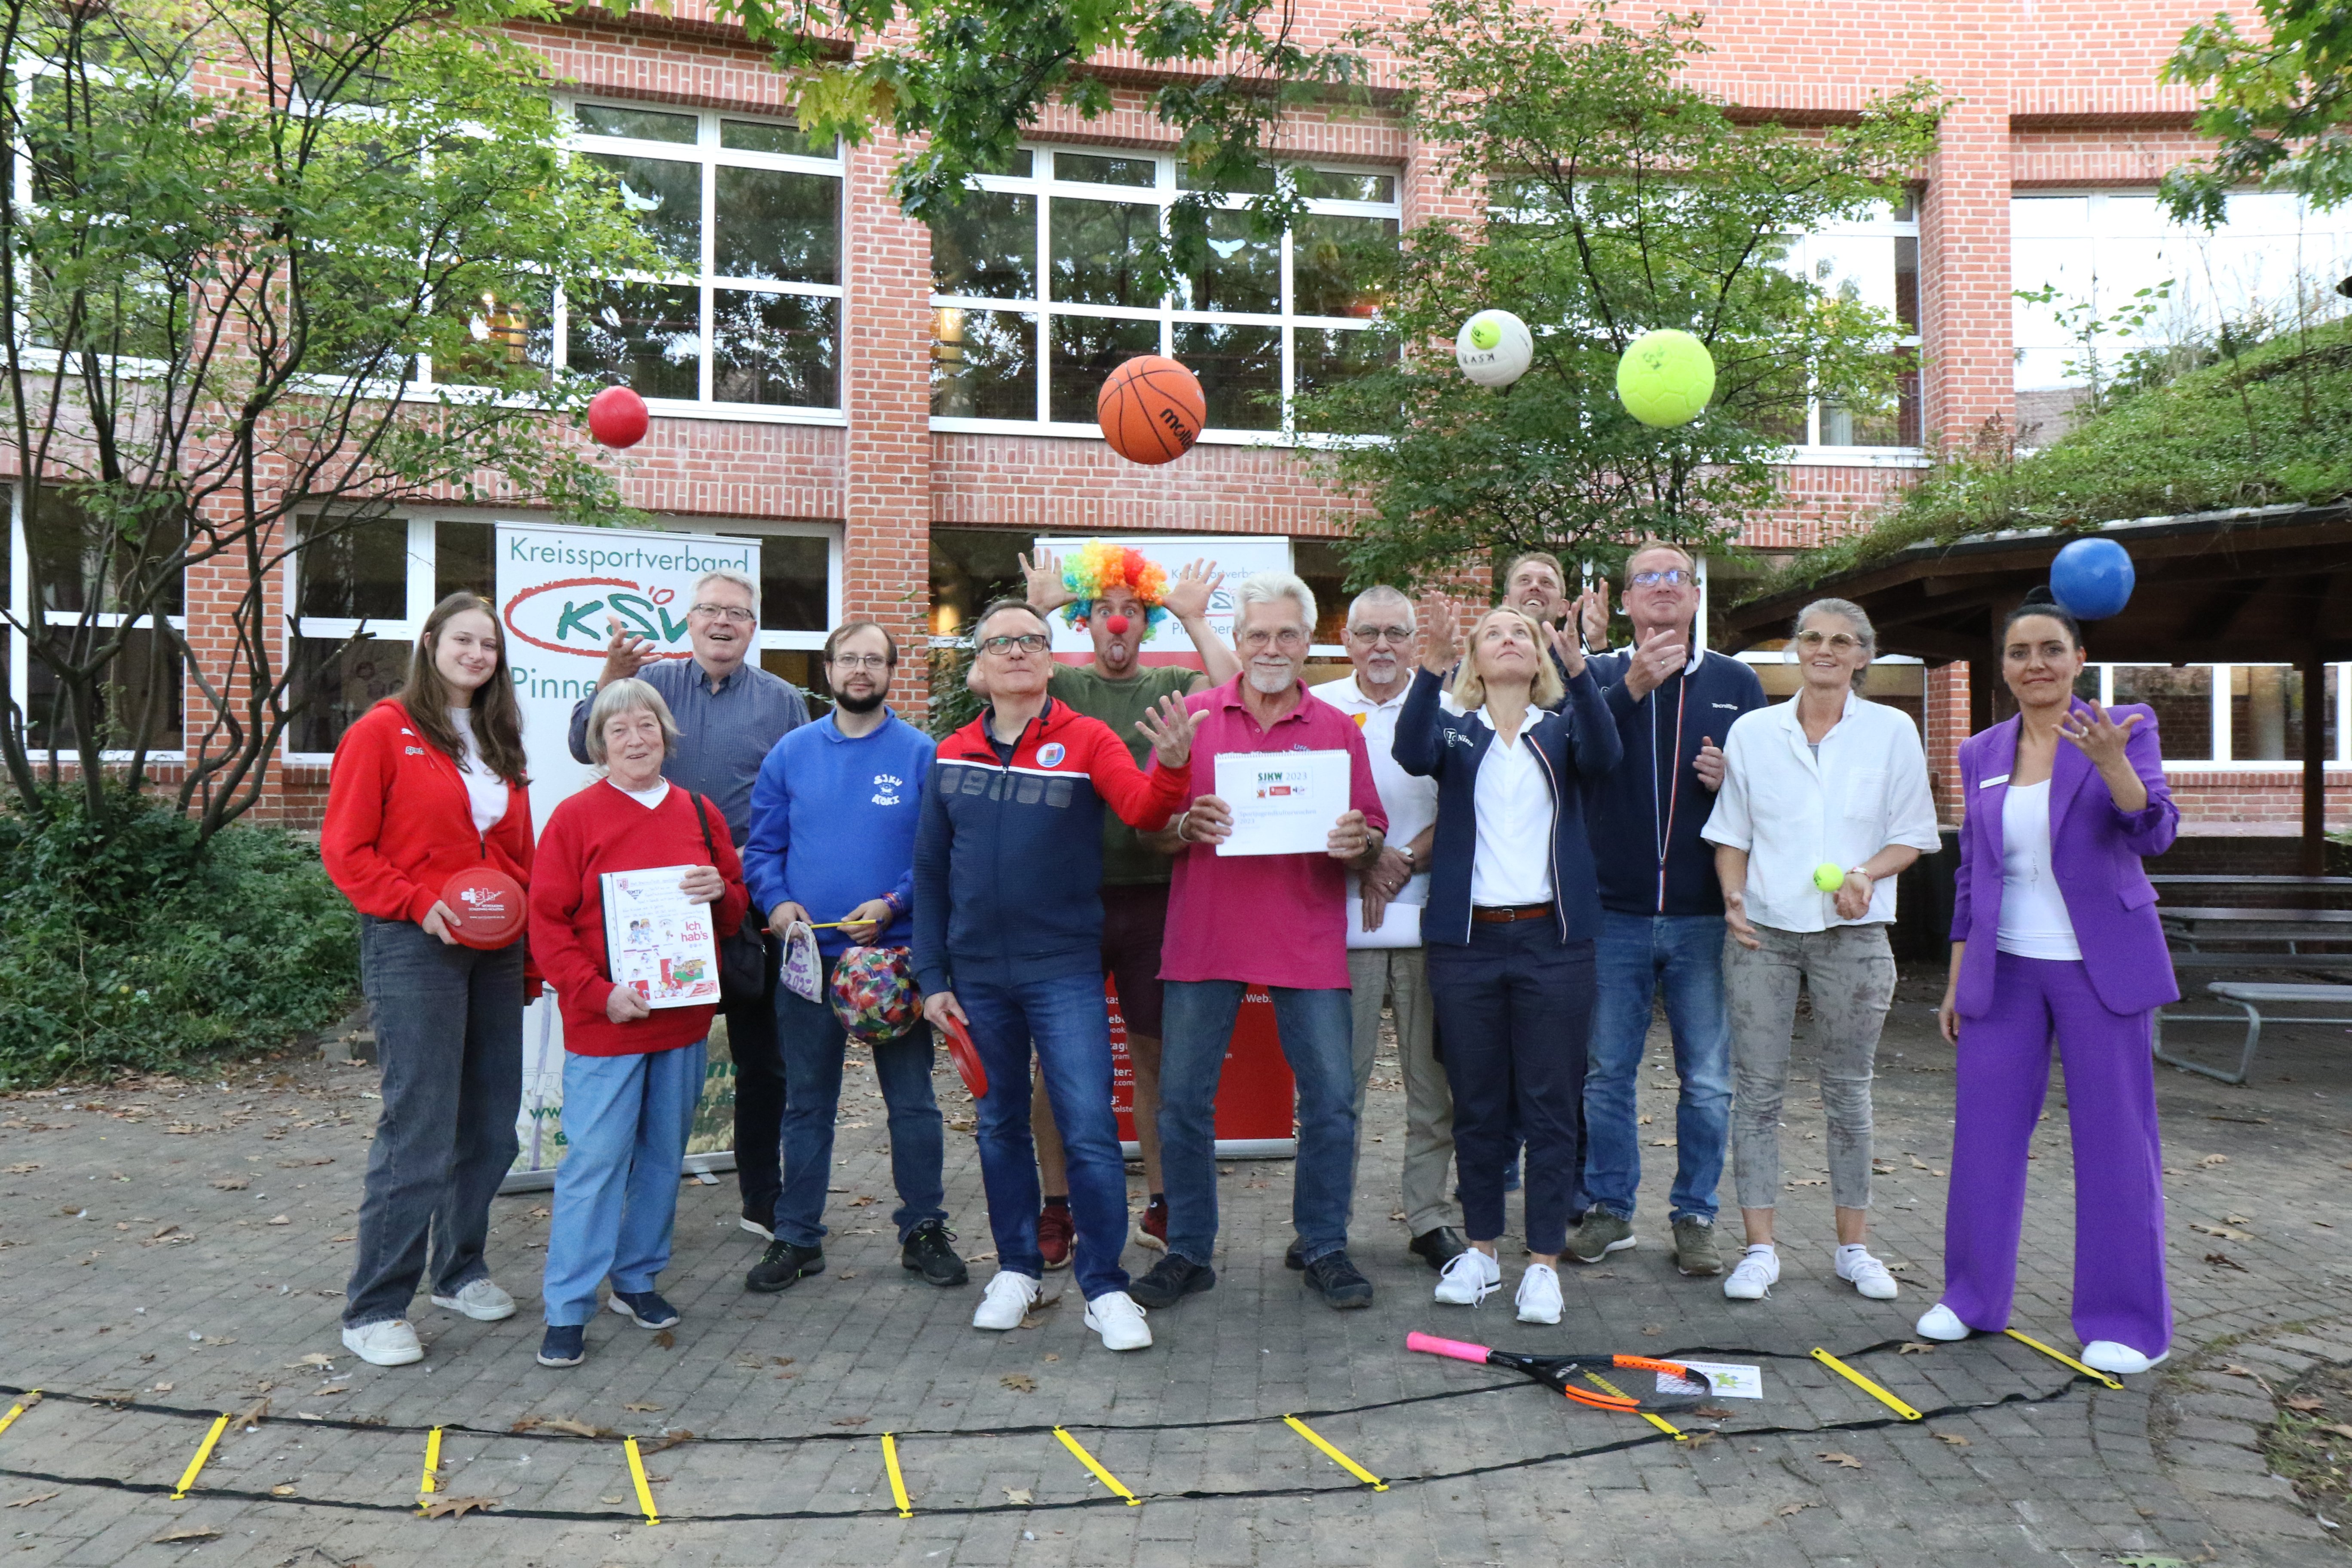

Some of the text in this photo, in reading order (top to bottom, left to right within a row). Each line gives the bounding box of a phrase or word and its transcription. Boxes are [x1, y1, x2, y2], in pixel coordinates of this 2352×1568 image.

[510, 536, 748, 573] Kreissportverband
[557, 594, 688, 643] KSV
[681, 931, 708, 942] hab's
[686, 922, 701, 931] Ich
